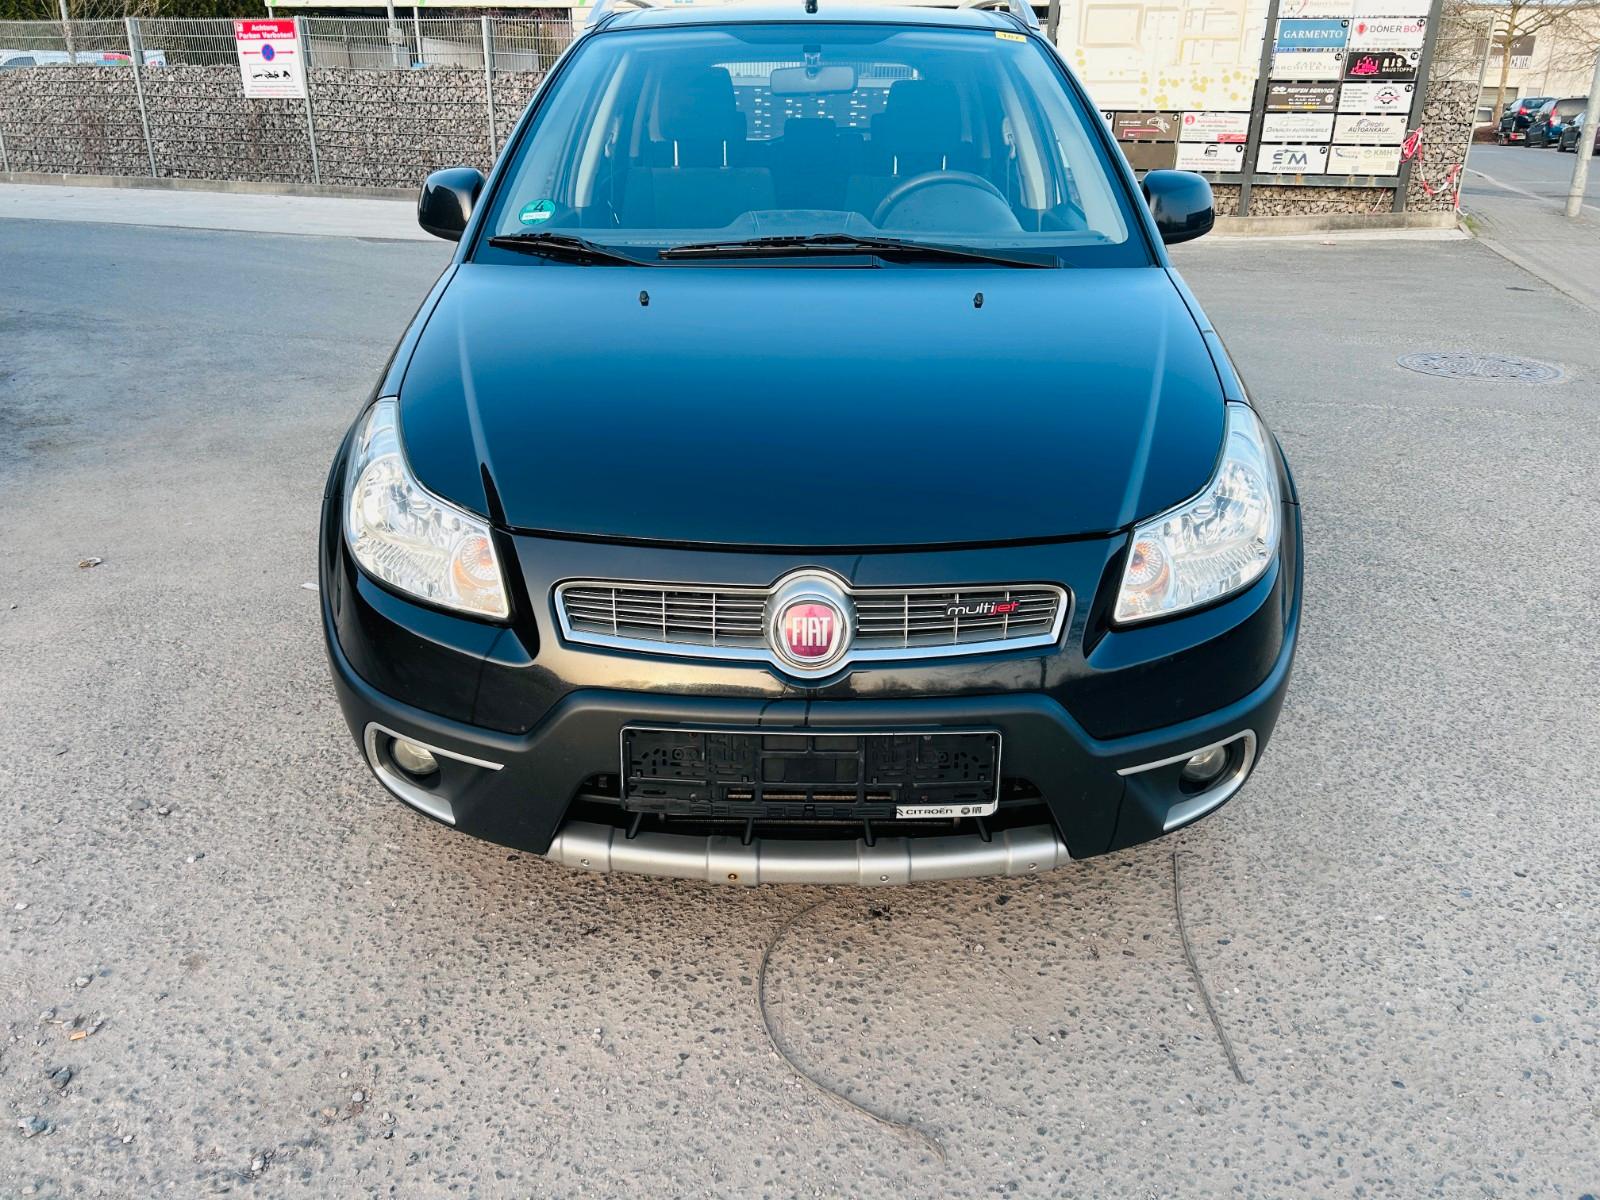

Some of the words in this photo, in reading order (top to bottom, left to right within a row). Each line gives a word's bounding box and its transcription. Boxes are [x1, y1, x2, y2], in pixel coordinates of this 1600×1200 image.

[251, 24, 278, 32] Achtung
[1403, 25, 1423, 33] BOX
[1284, 30, 1343, 39] GARMENTO
[533, 200, 545, 212] 4
[947, 601, 1019, 616] multijet
[791, 616, 831, 648] FIAT
